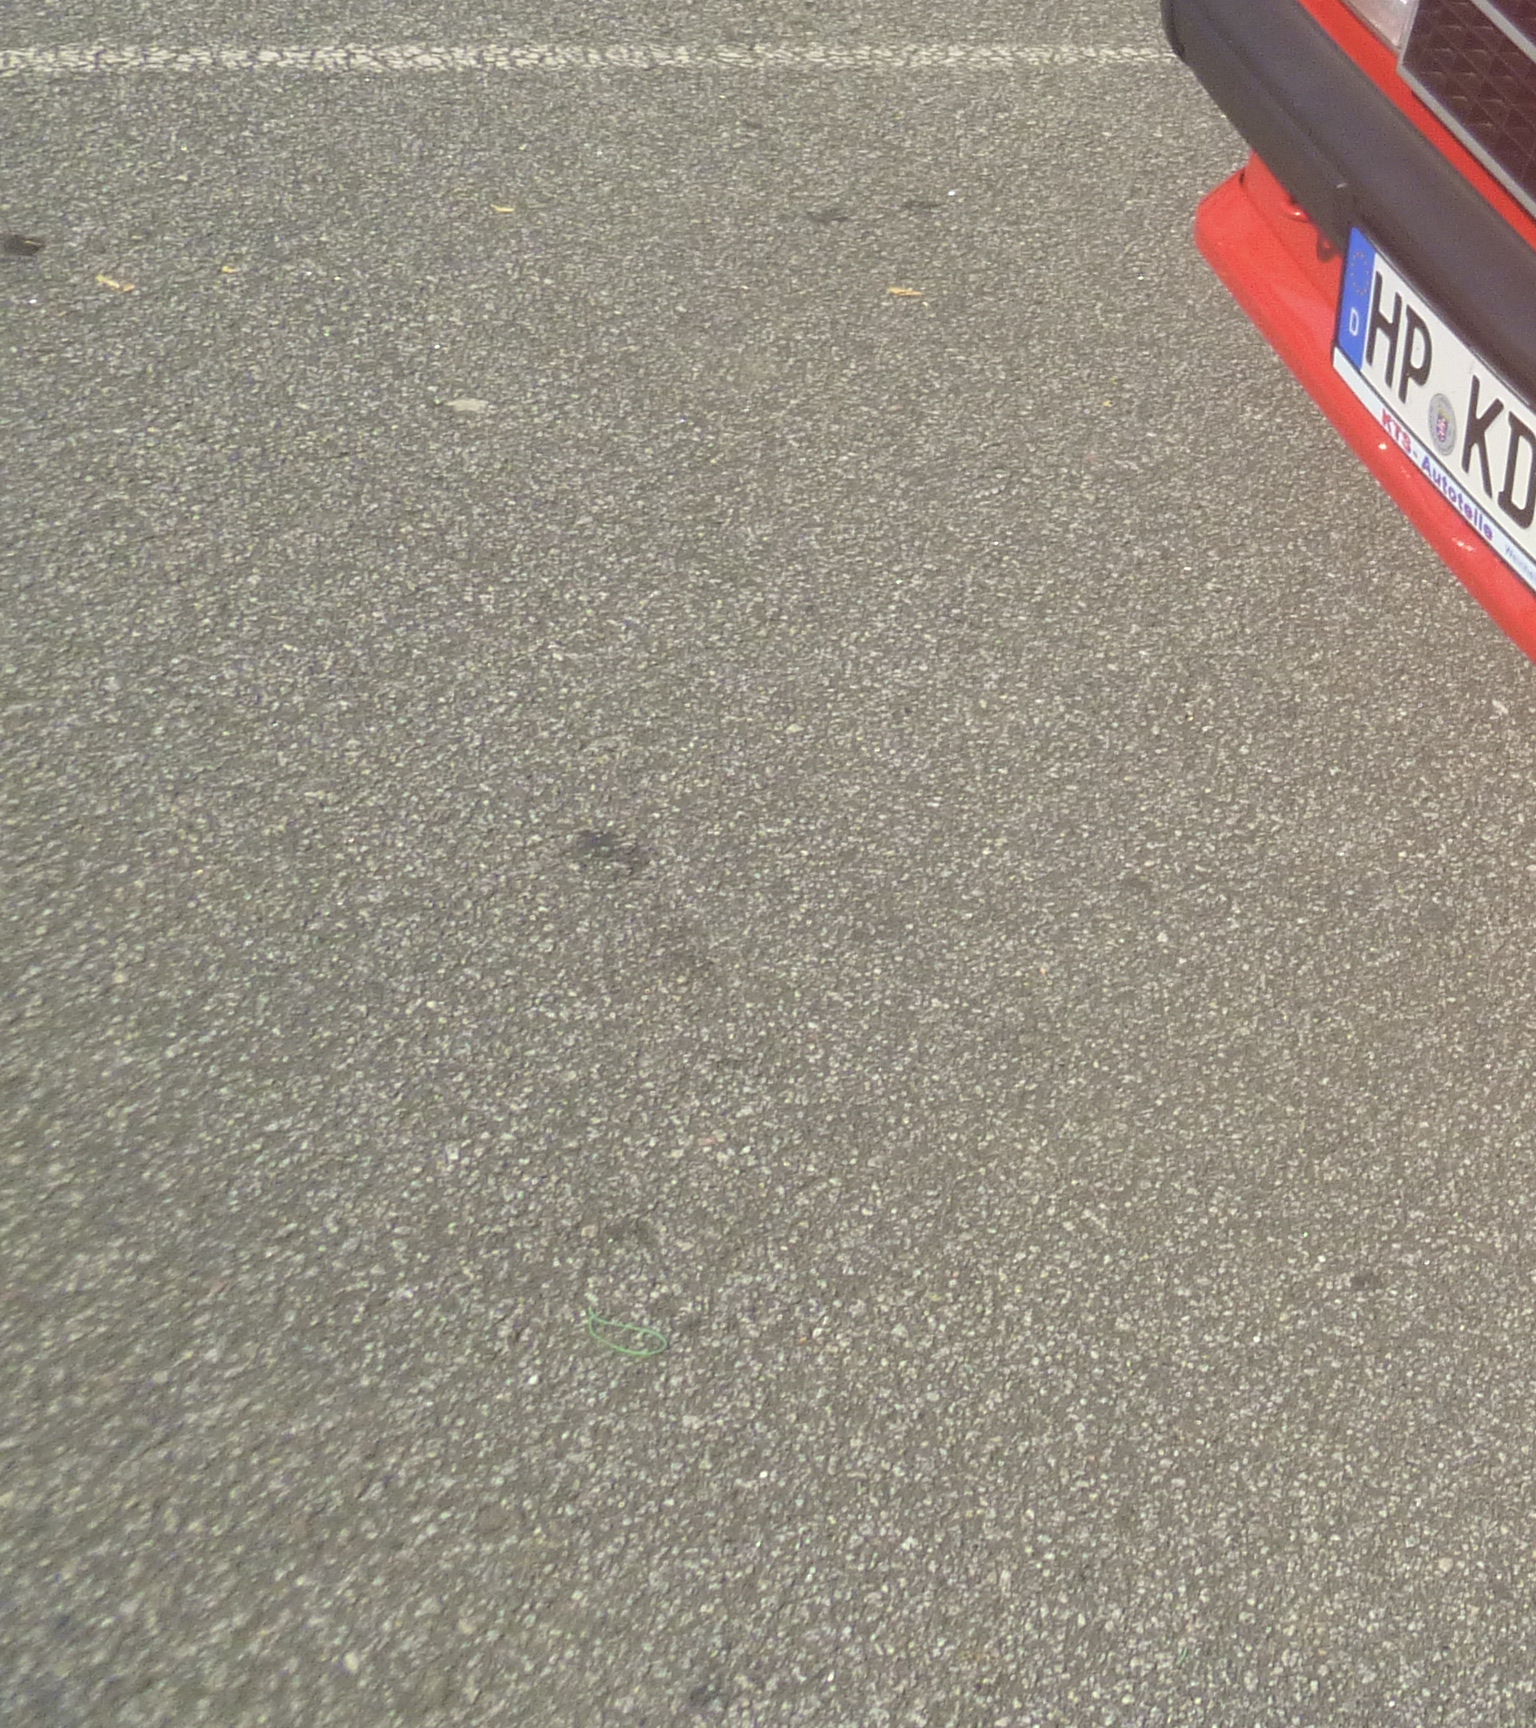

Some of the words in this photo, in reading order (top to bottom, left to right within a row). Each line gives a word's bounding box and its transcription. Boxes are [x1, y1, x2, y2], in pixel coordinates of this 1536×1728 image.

[1348, 306, 1360, 337] D
[1365, 270, 1433, 405] HP
[1420, 456, 1494, 542] Autoteile
